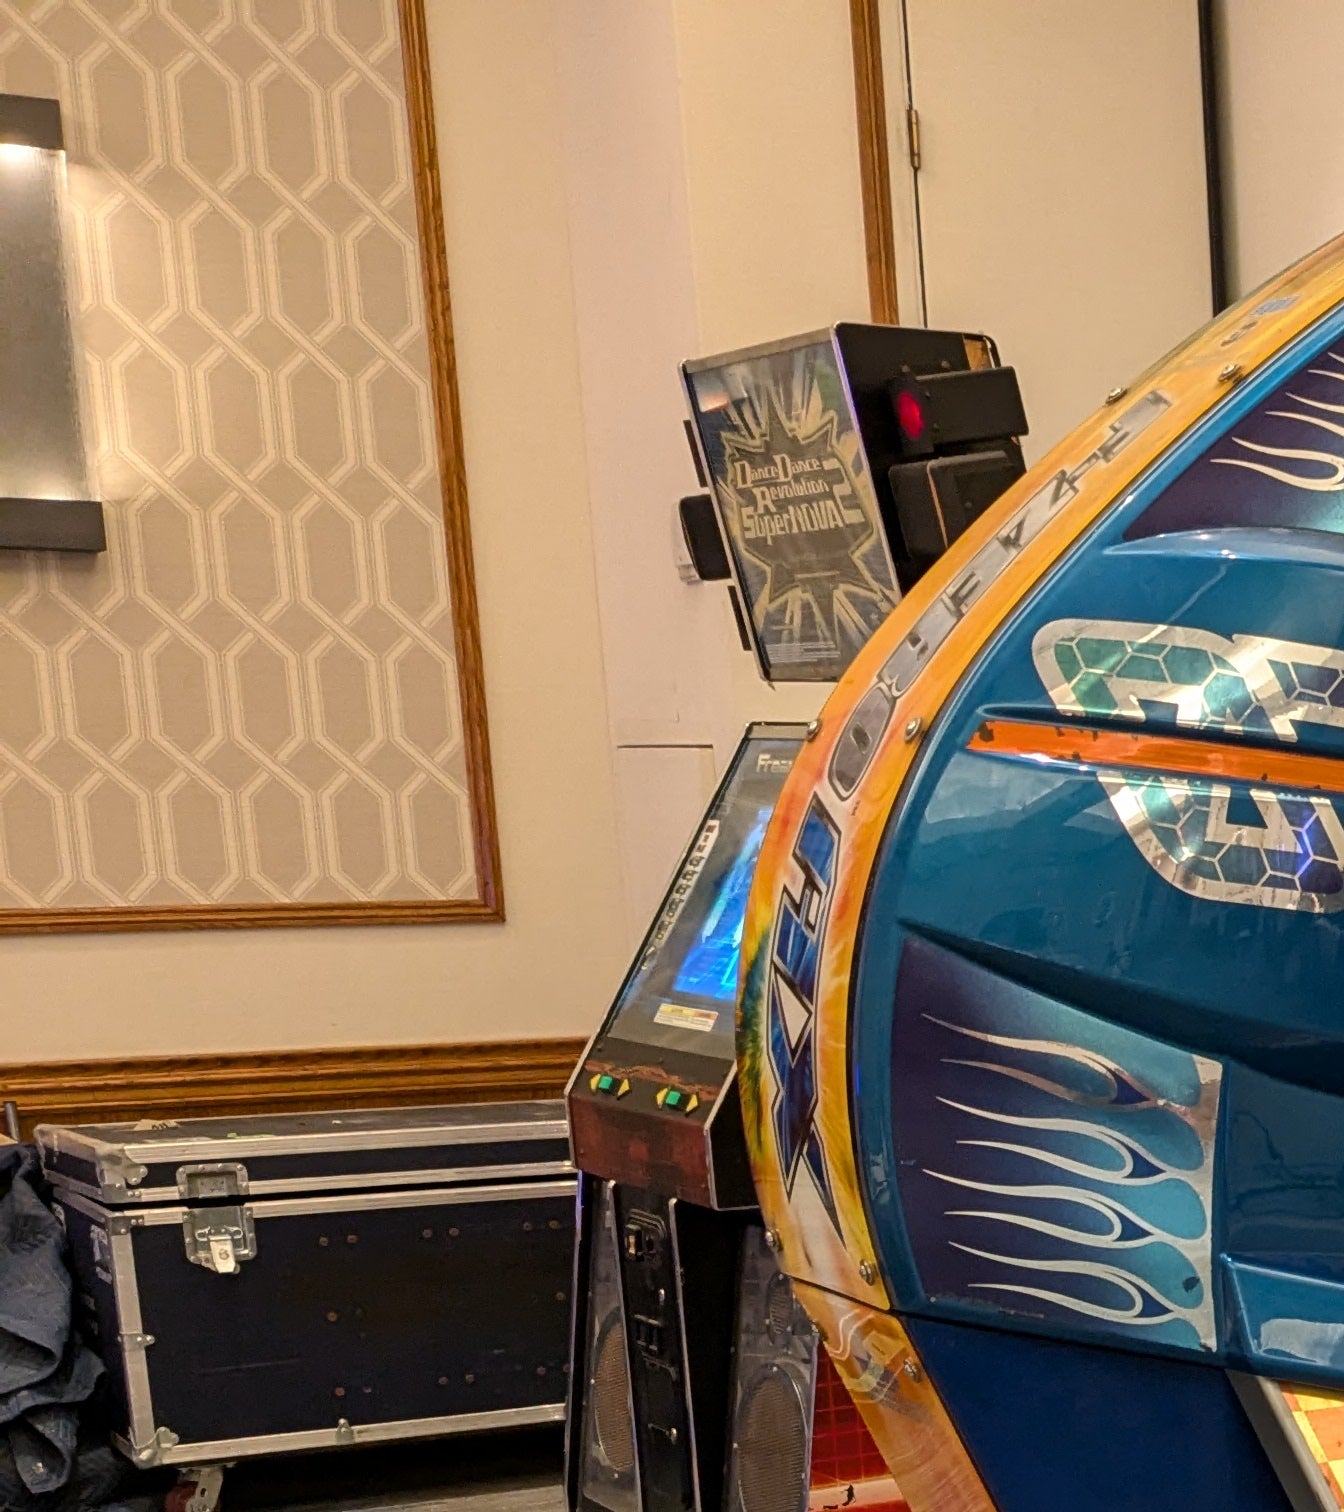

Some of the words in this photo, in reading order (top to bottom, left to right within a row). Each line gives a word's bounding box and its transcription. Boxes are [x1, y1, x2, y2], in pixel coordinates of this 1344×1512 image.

[734, 460, 778, 489] Dance
[773, 454, 822, 481] Dance
[752, 479, 830, 513] Revolution
